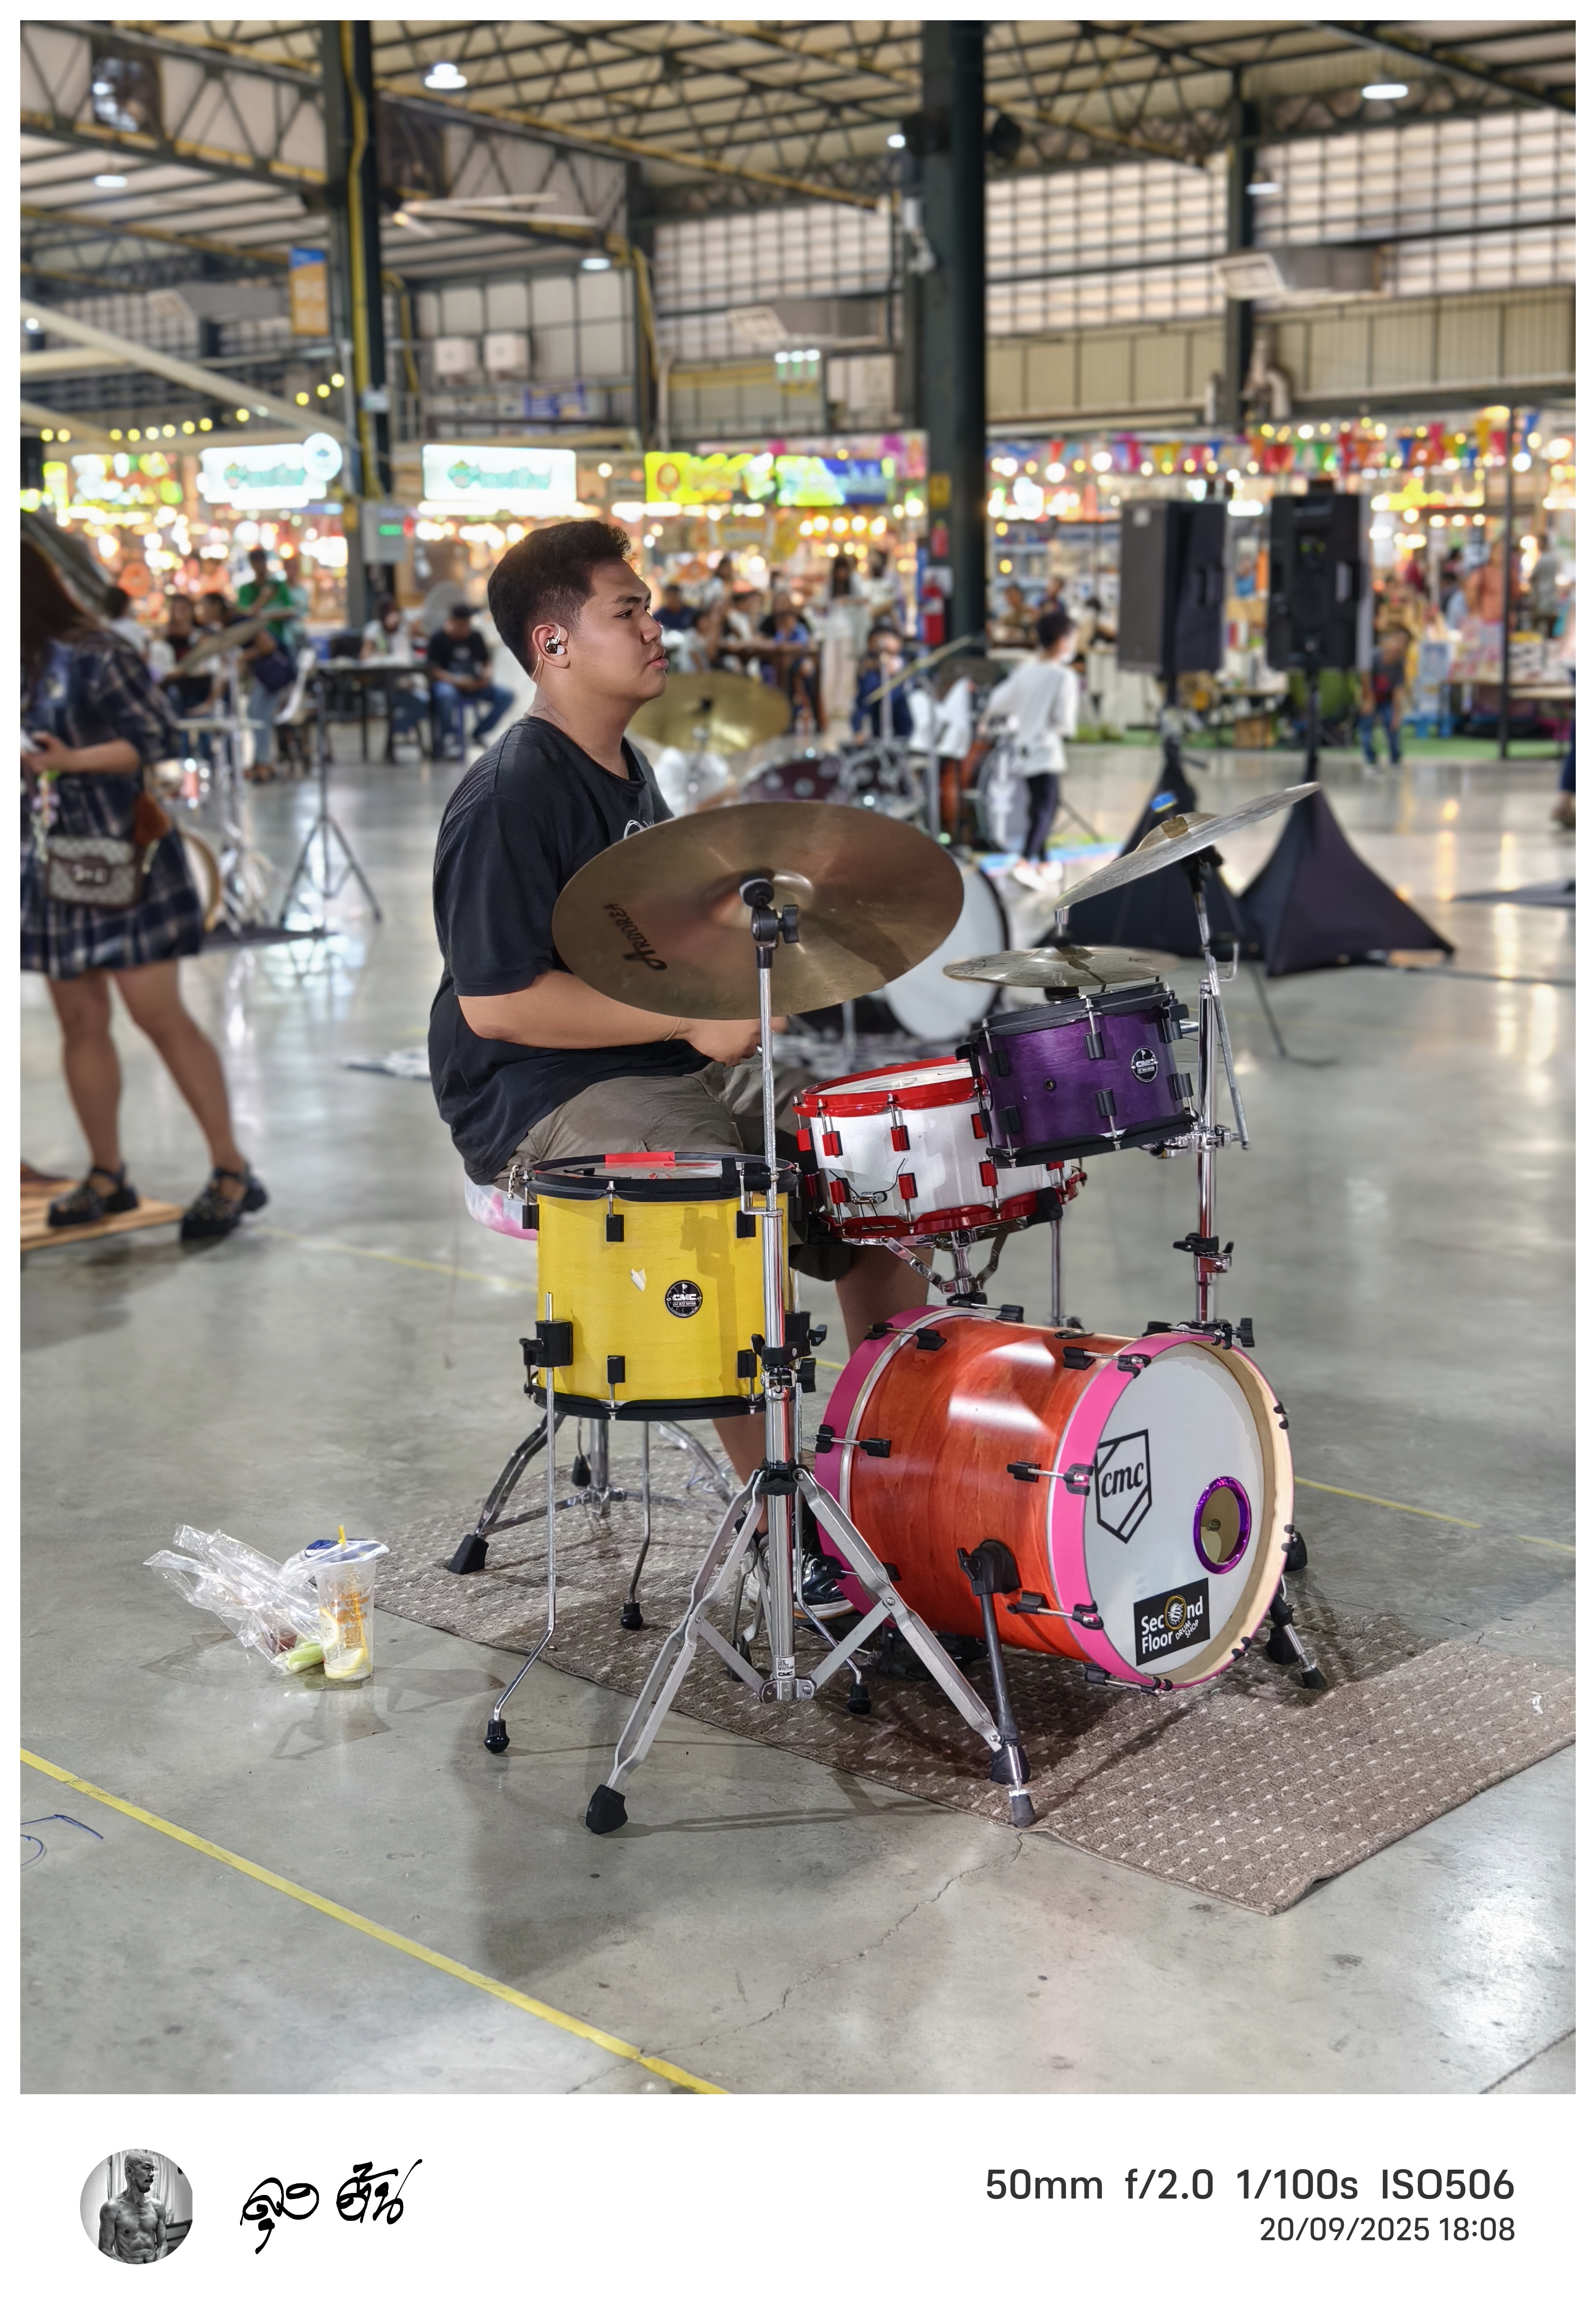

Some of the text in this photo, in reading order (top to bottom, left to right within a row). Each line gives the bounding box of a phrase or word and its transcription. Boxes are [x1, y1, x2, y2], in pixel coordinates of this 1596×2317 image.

[1101, 1462, 1144, 1498] cmc
[1175, 1620, 1192, 1640] DRUM
[1185, 1619, 1199, 1639] SHOP
[1142, 1631, 1173, 1654] Floor
